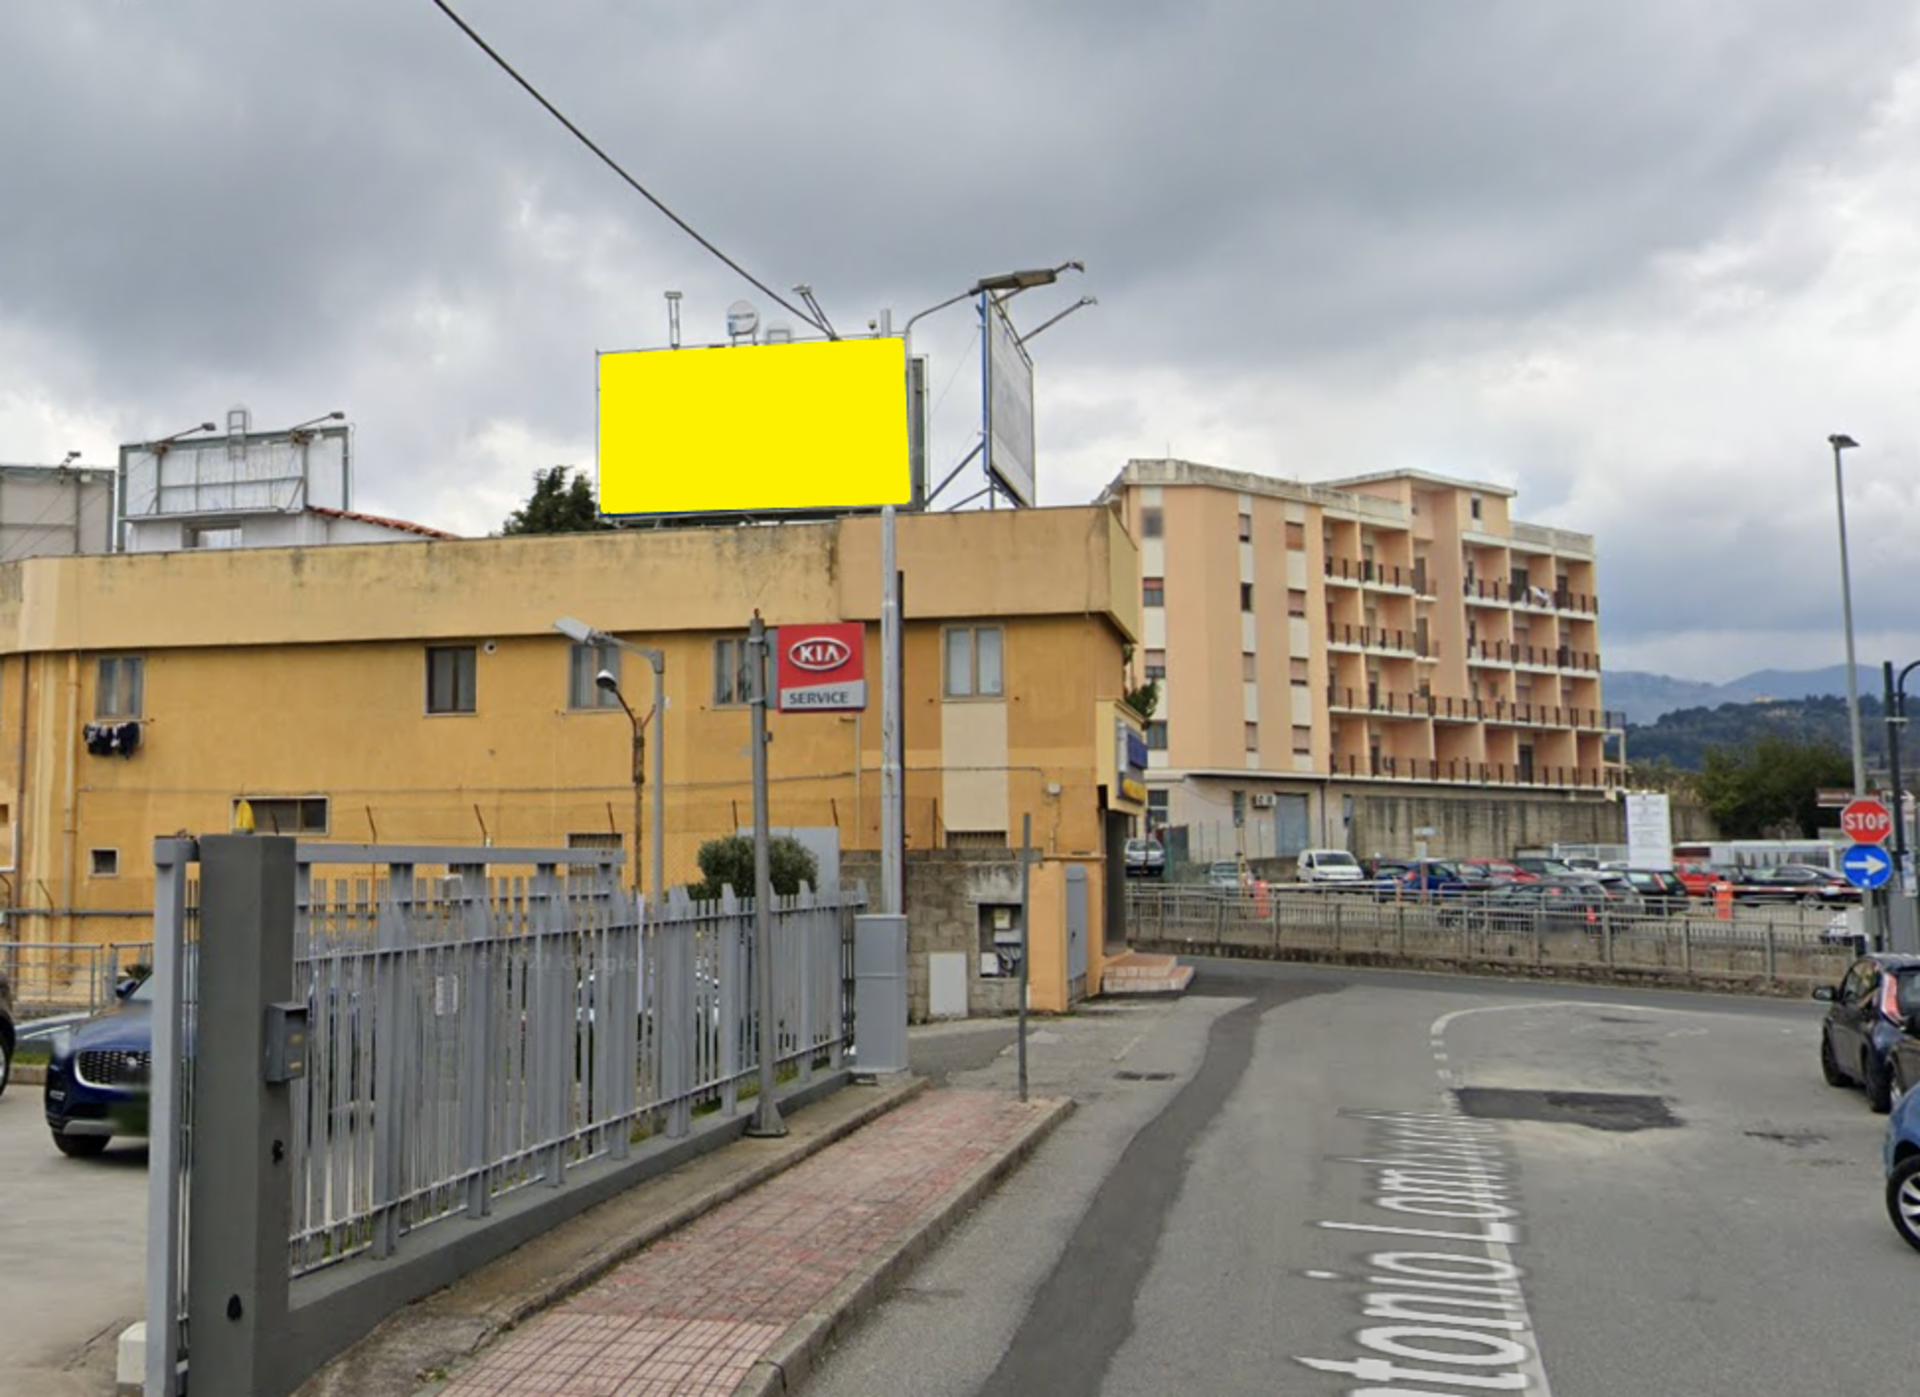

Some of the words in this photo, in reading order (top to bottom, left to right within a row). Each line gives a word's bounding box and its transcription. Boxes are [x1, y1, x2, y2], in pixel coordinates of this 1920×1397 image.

[799, 644, 841, 663] KIA
[789, 691, 849, 705] SERVICE
[1844, 812, 1888, 831] STOP
